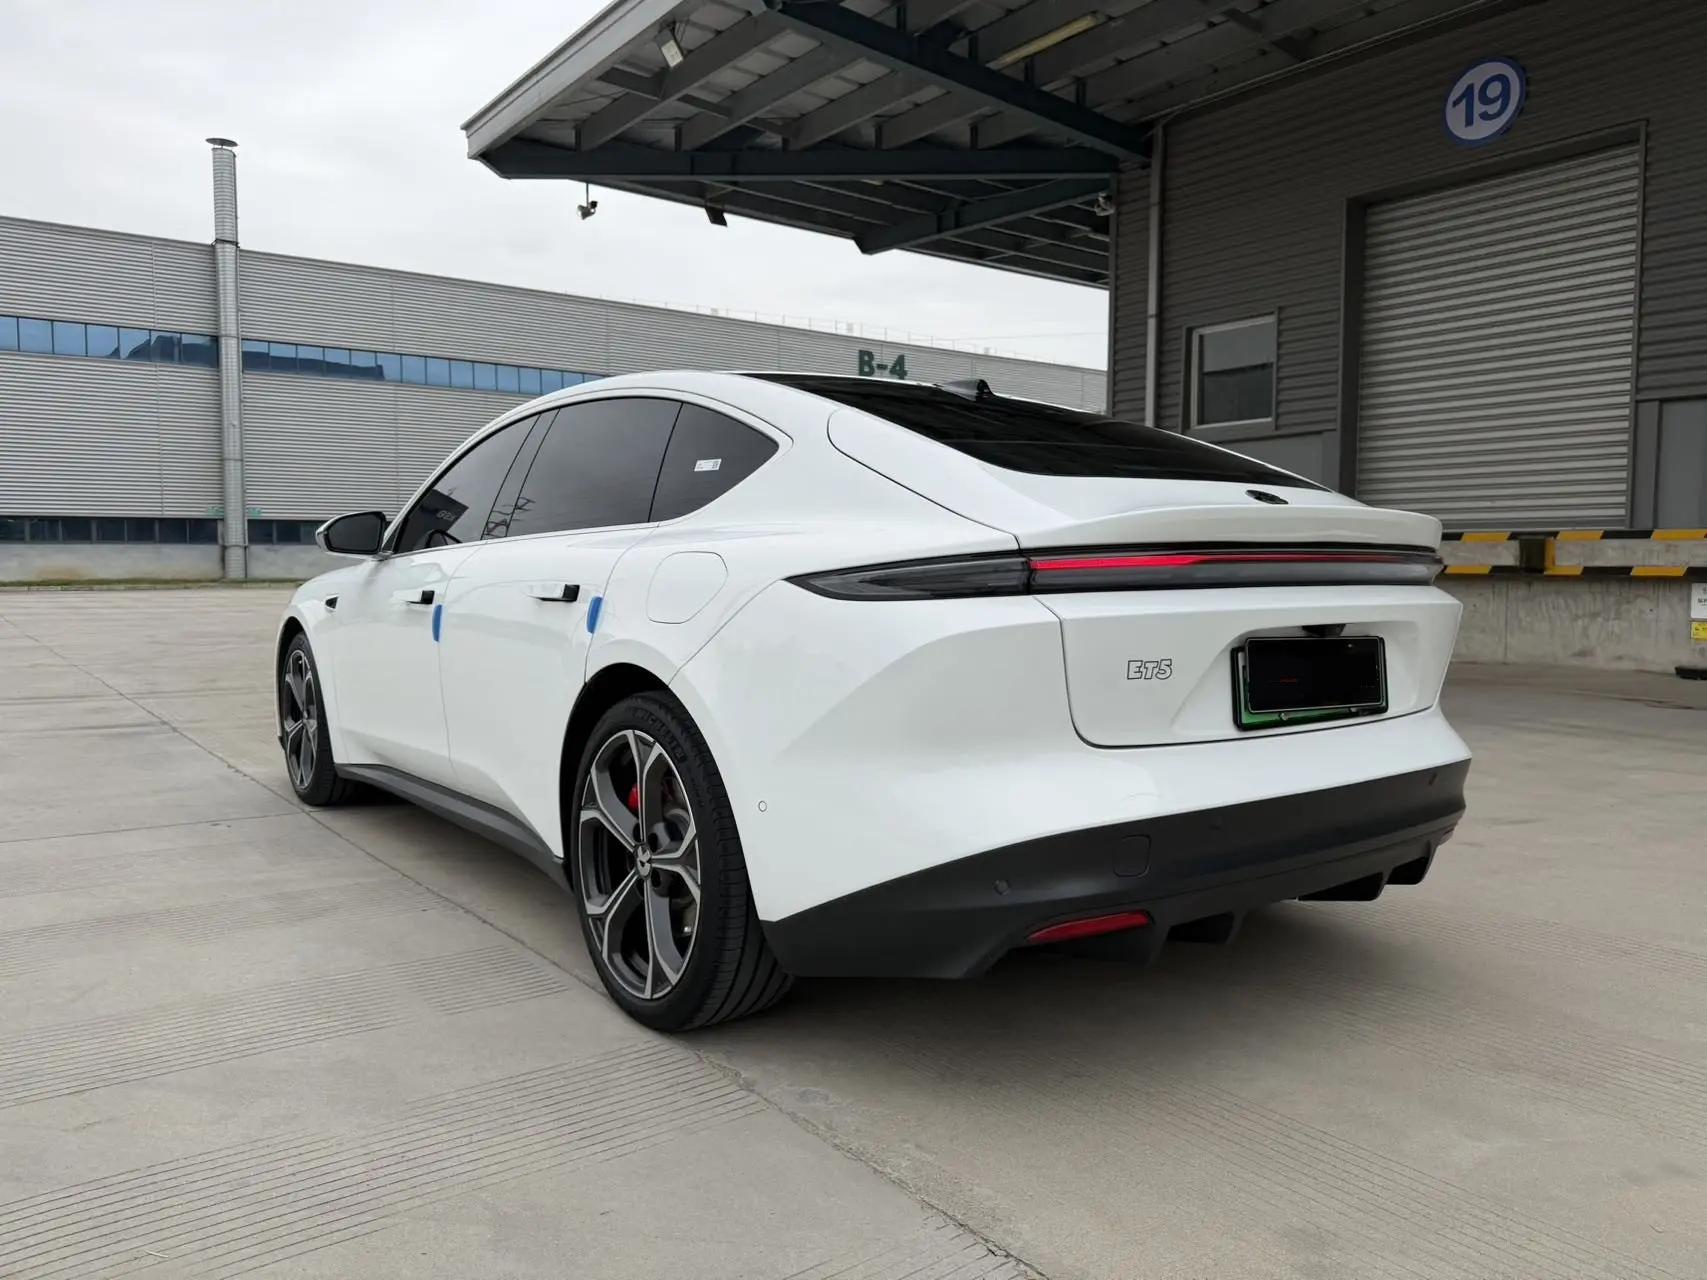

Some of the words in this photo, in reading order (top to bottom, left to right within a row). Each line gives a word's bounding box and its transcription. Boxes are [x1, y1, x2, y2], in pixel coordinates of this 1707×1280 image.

[1452, 73, 1511, 128] 19
[858, 350, 908, 380] B-4
[1127, 659, 1172, 680] ET5
